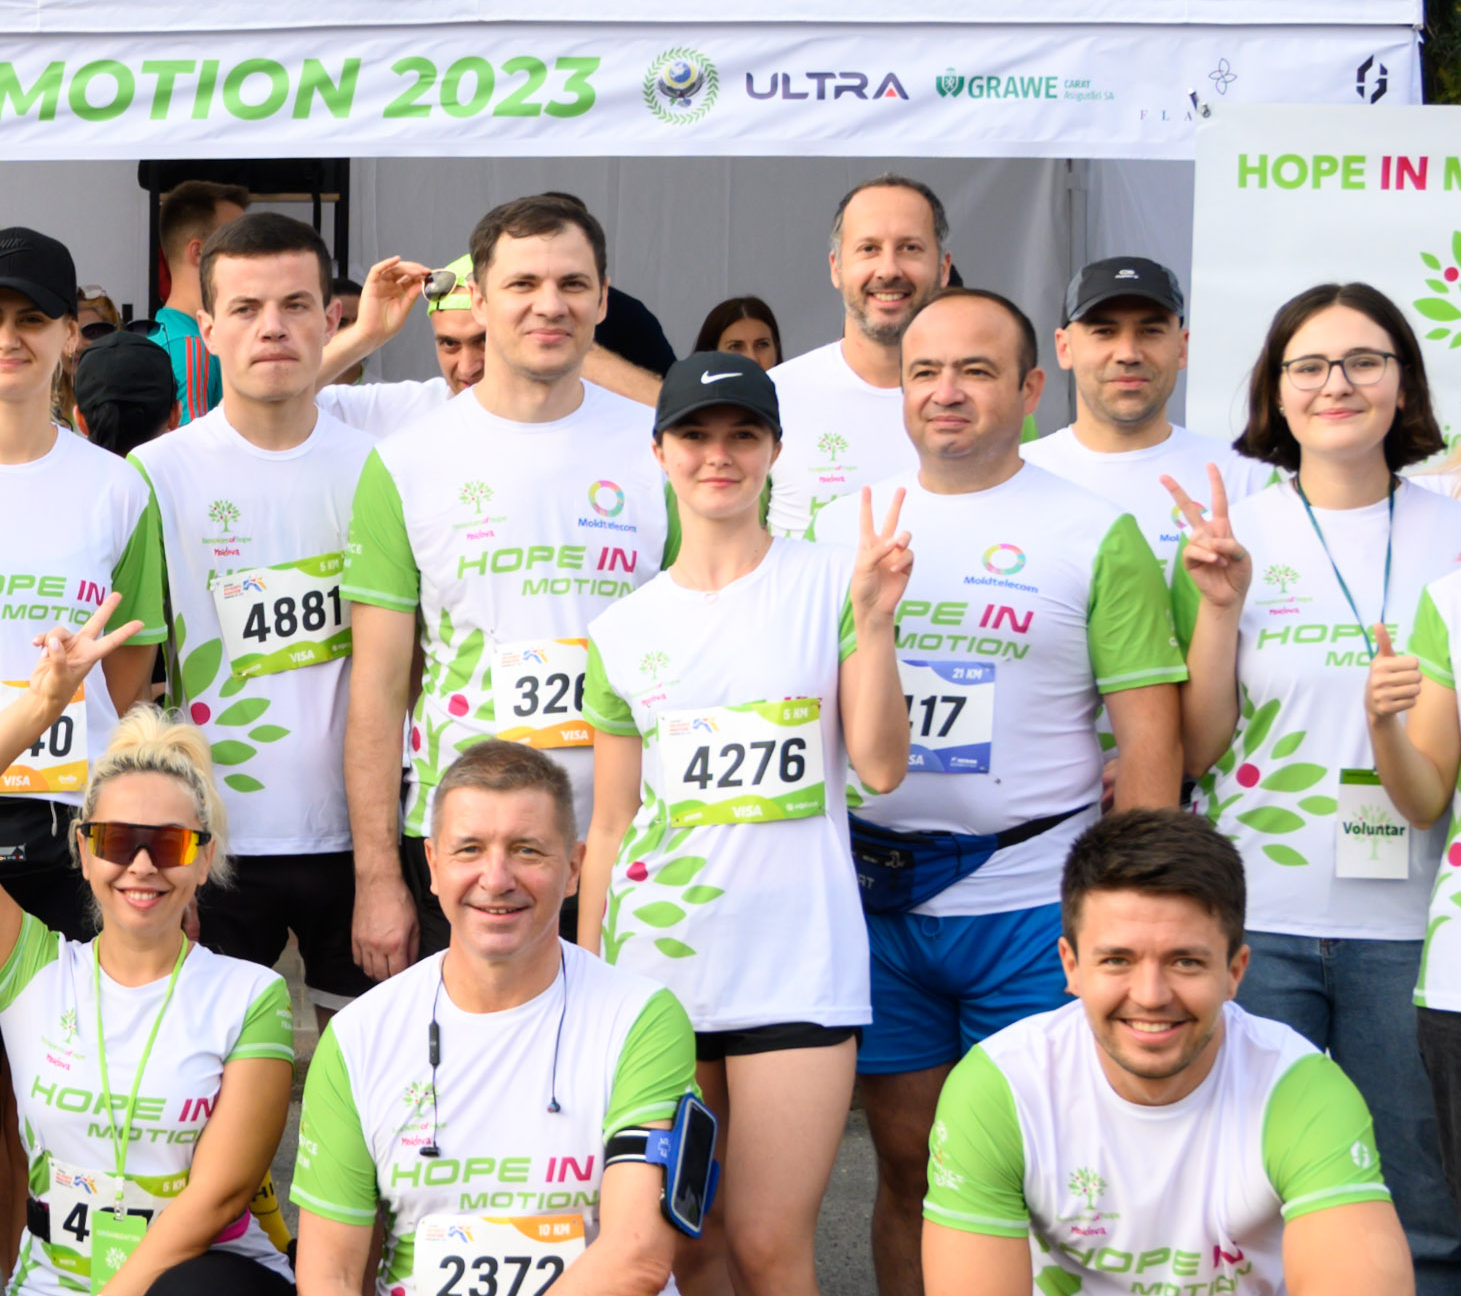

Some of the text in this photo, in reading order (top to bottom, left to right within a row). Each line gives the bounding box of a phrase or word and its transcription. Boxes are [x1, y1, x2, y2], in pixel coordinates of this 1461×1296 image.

[382, 55, 602, 119] 2023
[745, 71, 910, 101] ULTRA
[968, 75, 1058, 100] GRAWE
[1063, 79, 1091, 89] CARAT
[1237, 154, 1366, 190] HOPE
[1381, 156, 1428, 190] IN
[577, 517, 638, 534] Moldtelecom
[456, 544, 638, 580] HOPE IN
[76, 579, 106, 606] IN
[964, 575, 1039, 594] Moldtelecom
[1, 603, 92, 625] MOTIO
[242, 585, 343, 644] 4881
[895, 599, 1035, 634] PE IN
[289, 649, 315, 663] VISA
[951, 666, 983, 680] 21 KM
[560, 729, 590, 742] VISA
[682, 737, 807, 790] 4276
[2, 775, 31, 787] VISA
[731, 805, 764, 818] VISA
[1343, 821, 1406, 837] Voluntar
[30, 1074, 220, 1123] HOPE IN
[390, 1155, 595, 1187] HOPE IN
[459, 1190, 599, 1210] MOTION
[538, 1223, 571, 1236] 10 KM
[1060, 1242, 1202, 1276] HOPE
